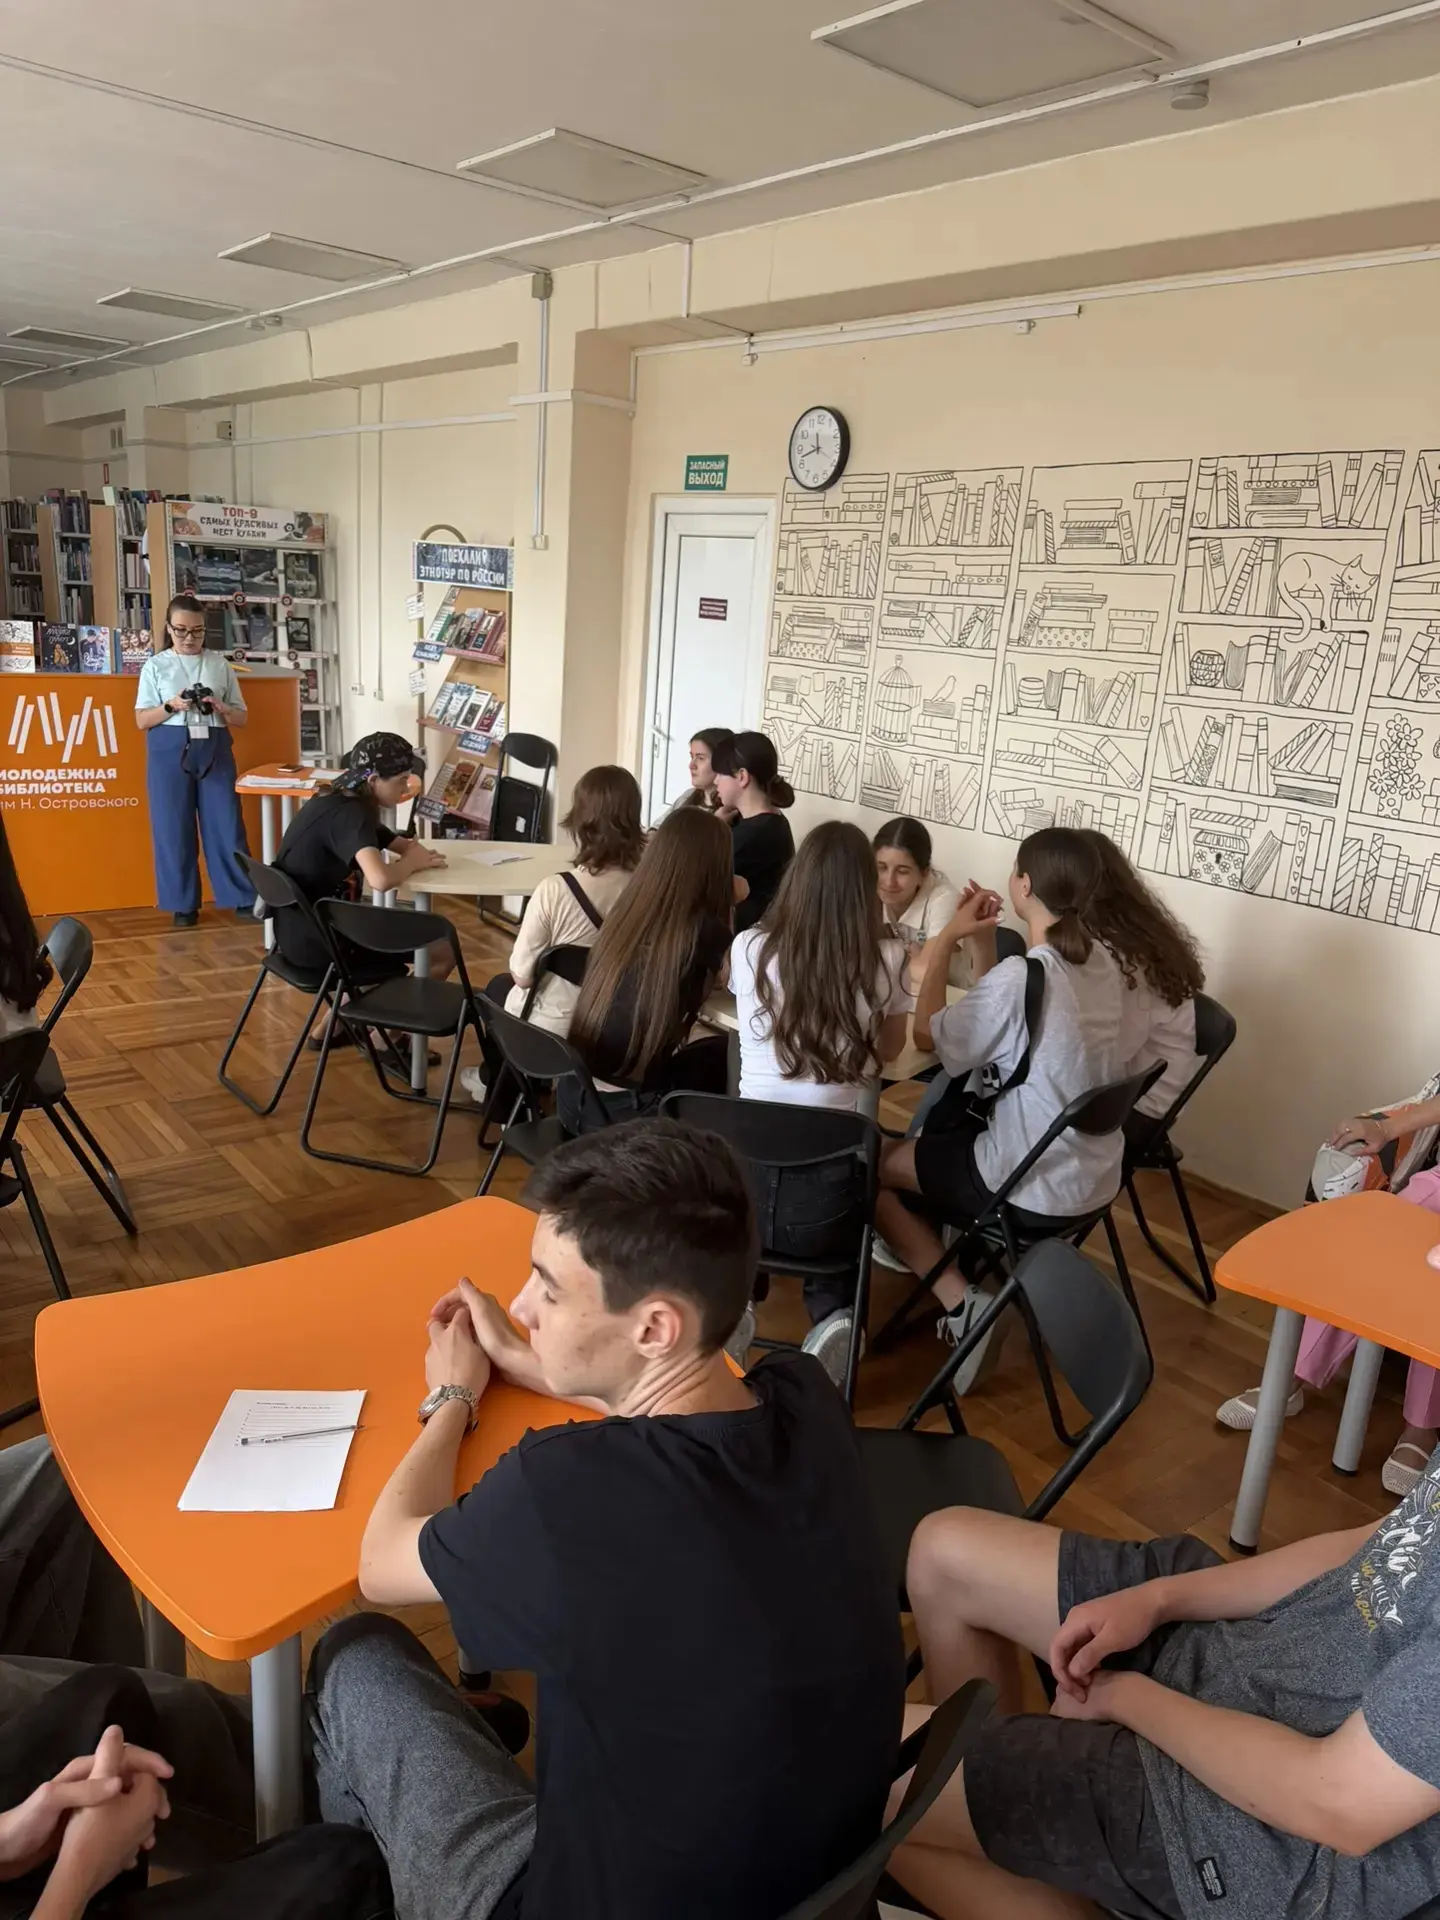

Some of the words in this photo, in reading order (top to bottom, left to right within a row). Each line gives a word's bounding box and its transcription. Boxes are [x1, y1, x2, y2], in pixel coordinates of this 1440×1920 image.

[808, 418, 815, 428] 11
[817, 414, 825, 425] 12
[801, 430, 809, 440] 10
[833, 429, 840, 439] 2
[797, 445, 804, 455] 9
[834, 444, 840, 454] 3
[690, 460, 725, 470] ЗАПАСНЫЙ
[798, 459, 805, 469] 8
[805, 469, 811, 479] 7
[812, 473, 819, 484] 6
[822, 469, 829, 480] 5
[689, 472, 724, 487] ВЫХОД
[222, 506, 258, 519] ТОП-9
[200, 516, 231, 526] САМЫХ
[234, 518, 279, 529] КРАСИВЫХ
[213, 528, 234, 536] МЕСТ
[236, 528, 267, 538] КУБАНИ
[420, 565, 456, 580] ЭТНОТУР
[457, 569, 470, 581] ПО
[472, 568, 505, 585] РОССИИ
[20, 798, 36, 809] Н.
[39, 796, 139, 811] Островского
